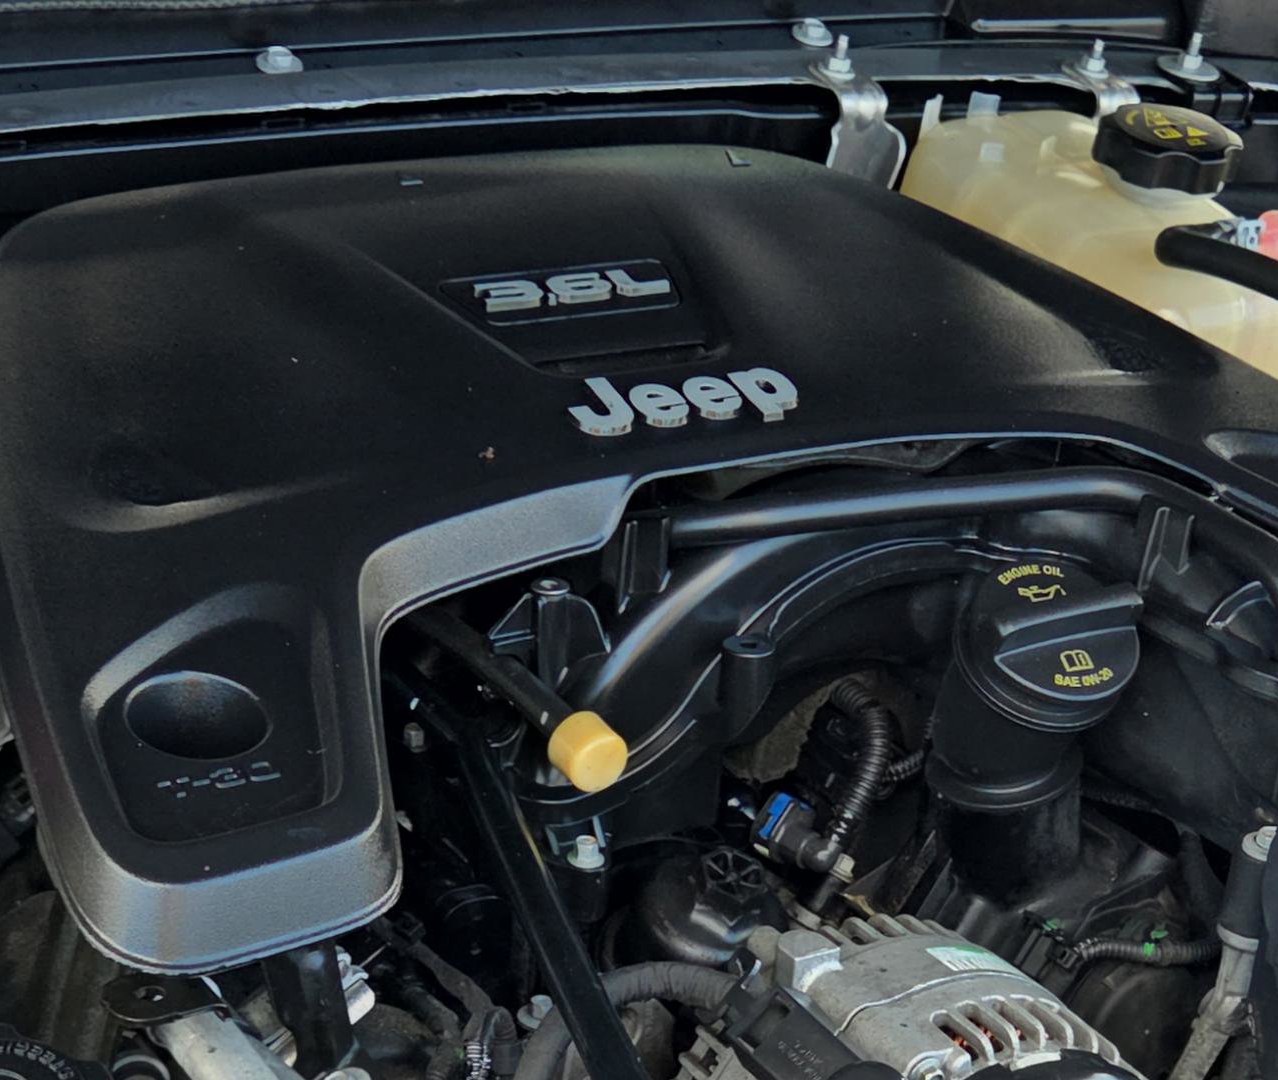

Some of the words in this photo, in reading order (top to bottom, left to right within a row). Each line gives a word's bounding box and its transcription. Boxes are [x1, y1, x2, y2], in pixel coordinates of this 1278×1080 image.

[473, 267, 671, 313] 3.6L
[567, 366, 799, 437] Jeep
[997, 563, 1041, 586] ENGINE
[1042, 564, 1066, 579] OIL
[1053, 673, 1082, 688] SAE
